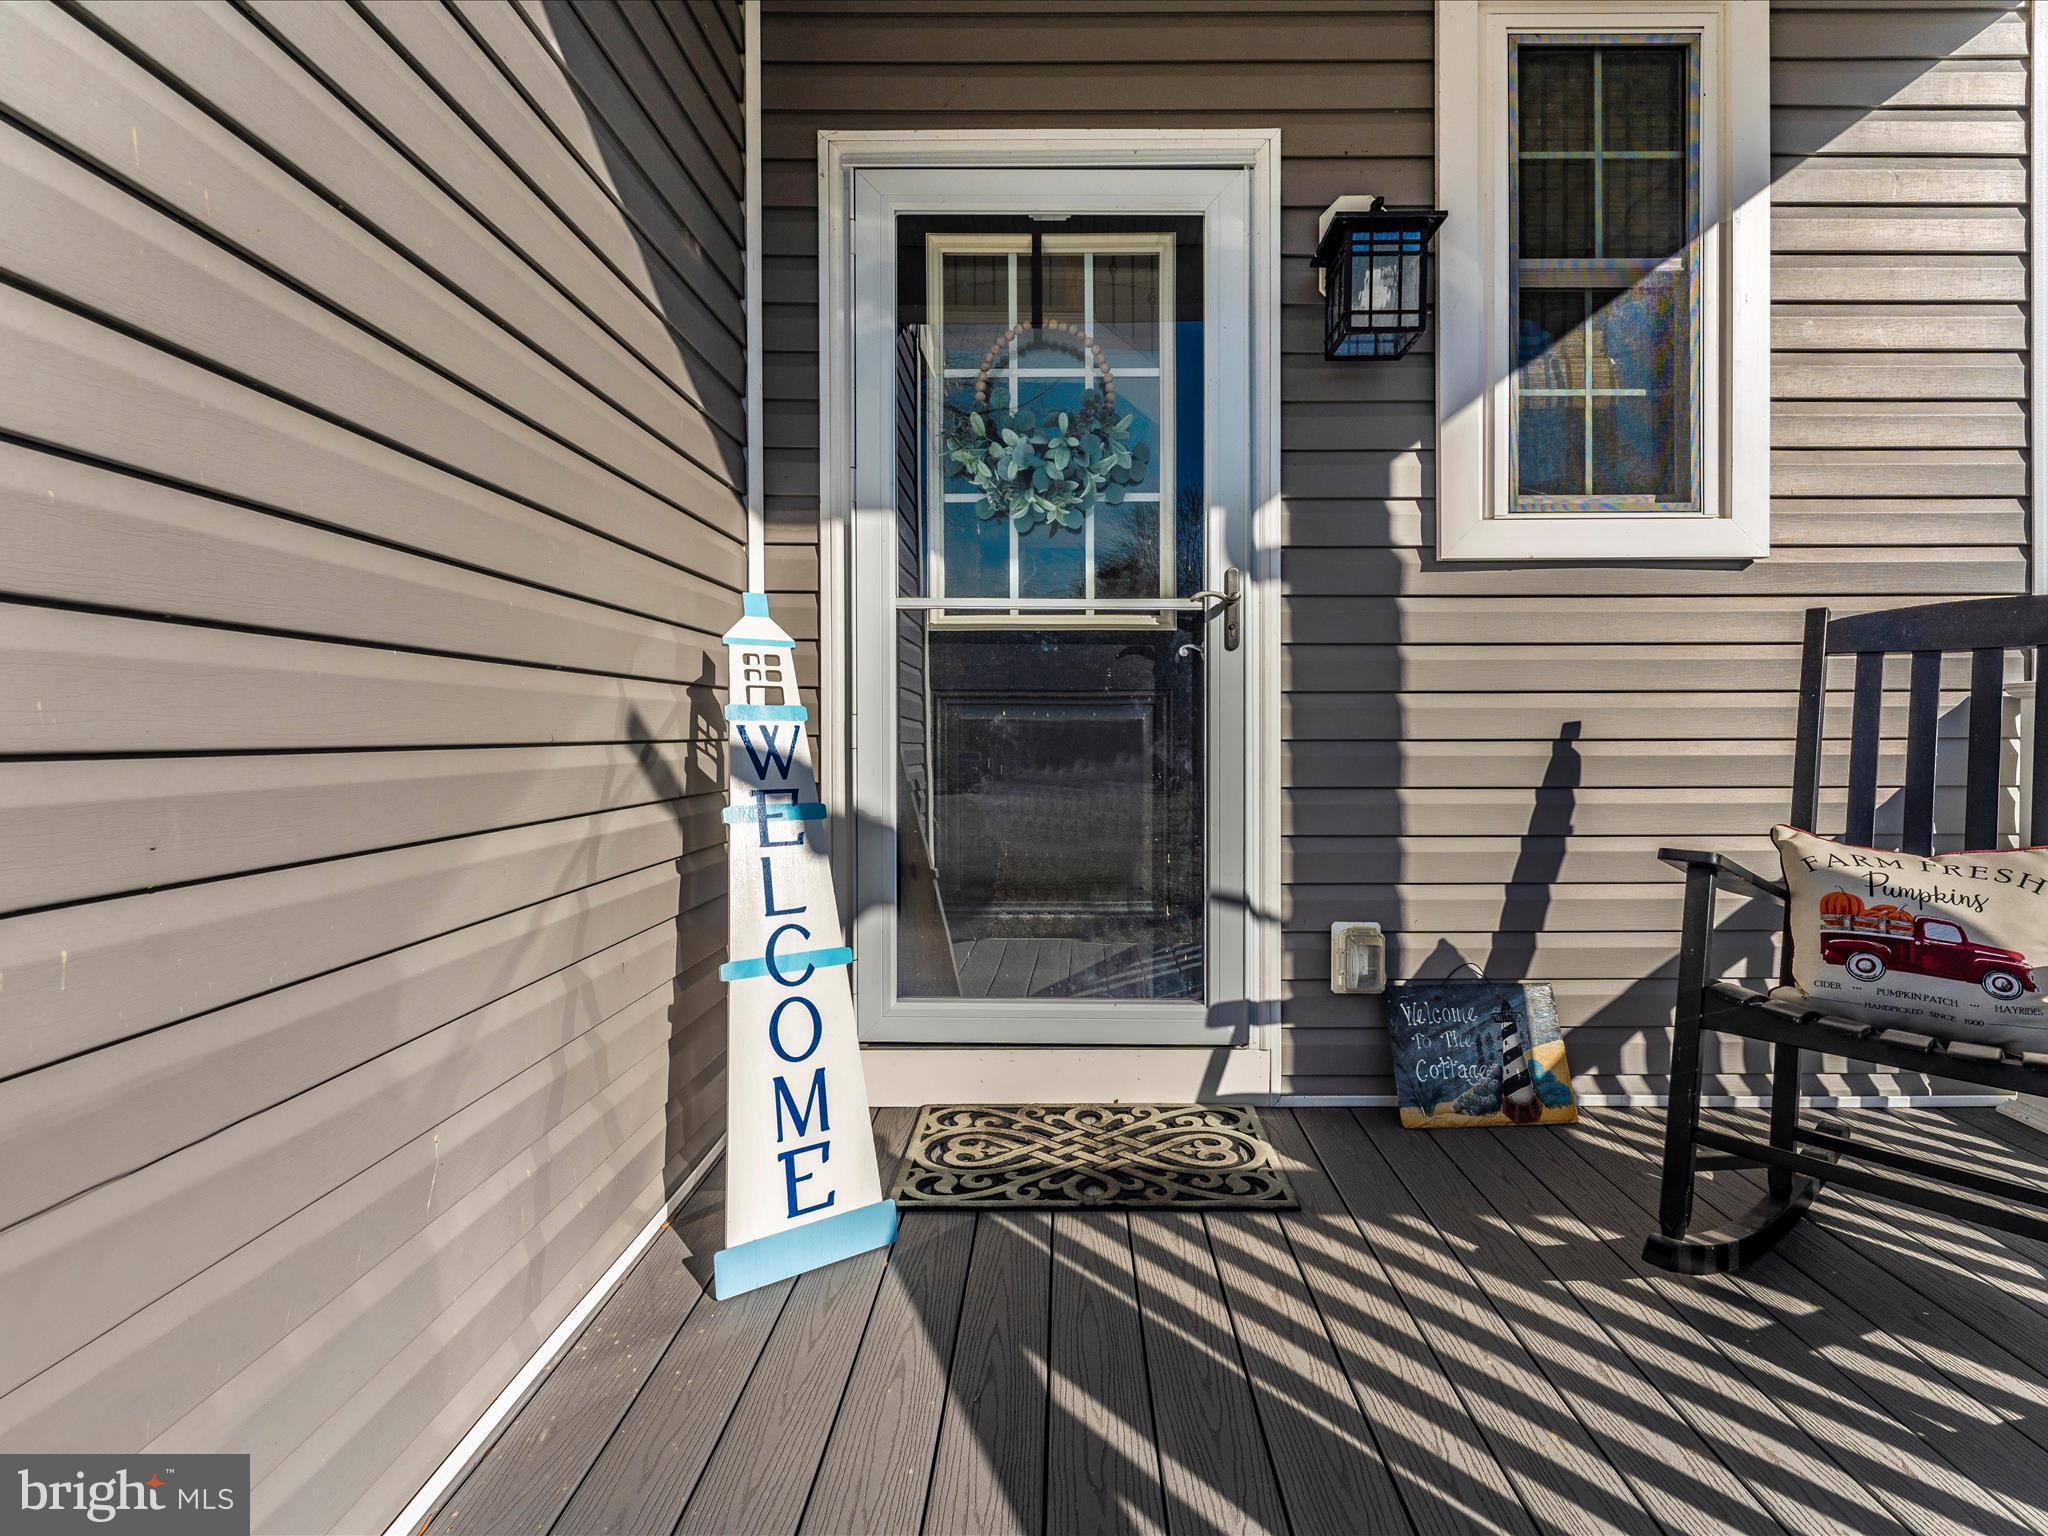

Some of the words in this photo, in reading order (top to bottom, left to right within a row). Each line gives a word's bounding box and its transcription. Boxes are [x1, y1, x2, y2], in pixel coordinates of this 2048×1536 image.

[1801, 853, 1905, 873] FARM
[1920, 859, 2048, 895] FRESH
[1862, 870, 1990, 913] Pumpkins
[736, 724, 836, 1219] WELCOME
[1400, 1001, 1478, 1026] Welcome
[1813, 979, 1842, 990] CIDER
[1876, 987, 1922, 1001] PUMPKIN
[1922, 993, 1959, 1008] PATCH
[1994, 1004, 2044, 1016] HAYRIDES
[1863, 1002, 1924, 1016] HANDPICKED
[1928, 1011, 1957, 1023] SINCE
[1963, 1018, 1985, 1027] 1900
[1440, 1030, 1475, 1049] The
